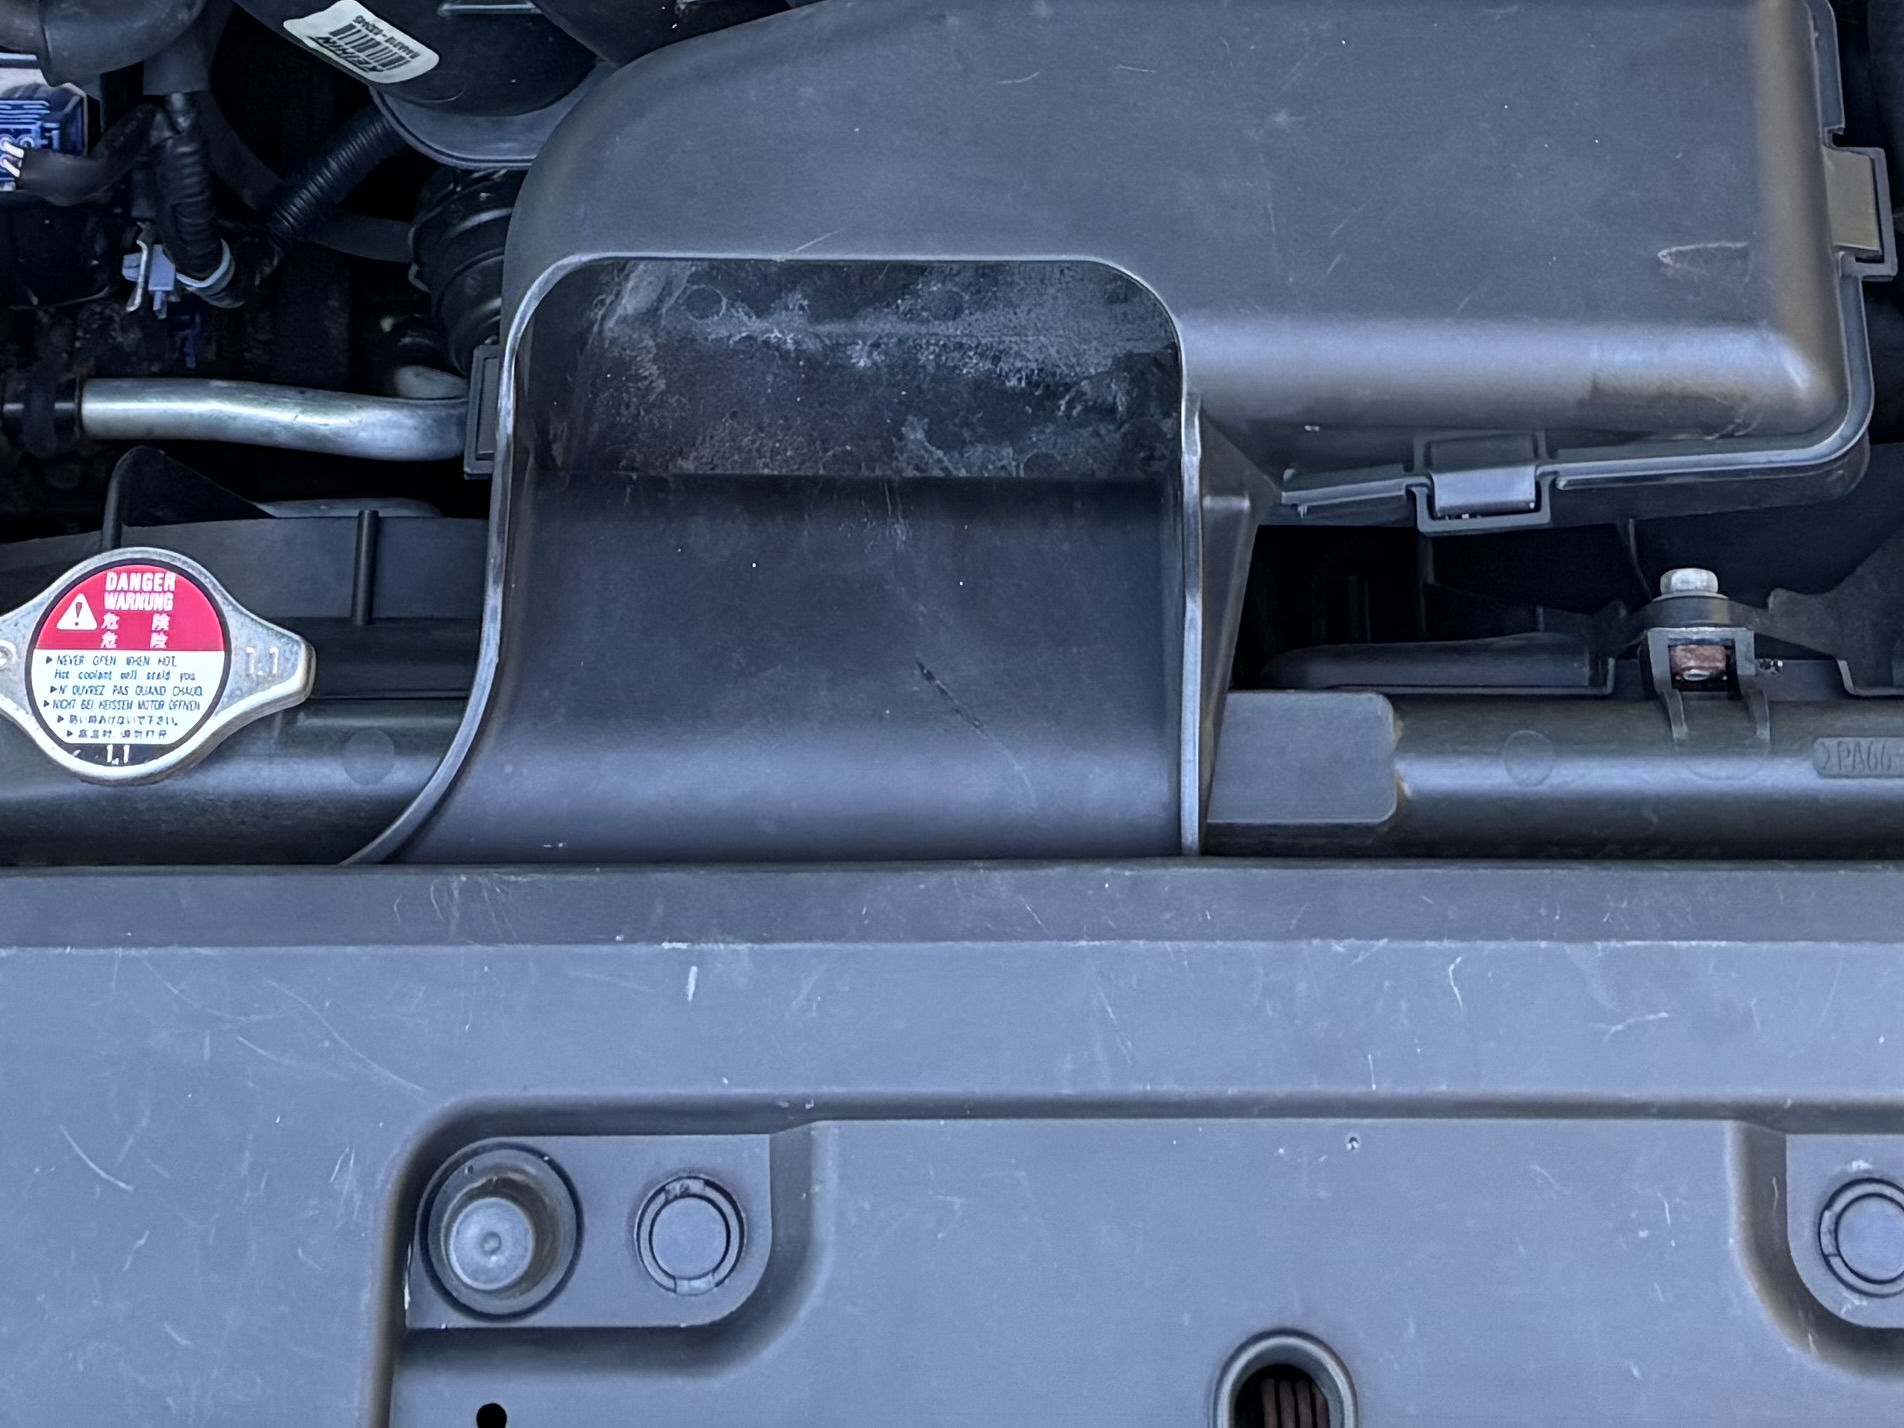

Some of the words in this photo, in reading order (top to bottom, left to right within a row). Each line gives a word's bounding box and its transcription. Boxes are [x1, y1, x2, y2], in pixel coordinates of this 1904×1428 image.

[105, 571, 176, 591] DANGER
[104, 592, 174, 611] WARNUNG
[56, 655, 84, 665] NEVER
[92, 656, 116, 665] OPEN
[126, 656, 149, 666] WHEN
[245, 646, 279, 675] 1.1
[54, 669, 68, 679] Hot
[78, 669, 111, 679] coolant
[72, 685, 104, 695] OUVREZ
[112, 685, 128, 695] PAS
[135, 685, 165, 695] QUAND
[52, 699, 76, 709] NICHT
[137, 699, 164, 710] MOTOR
[106, 744, 129, 764] 1.1
